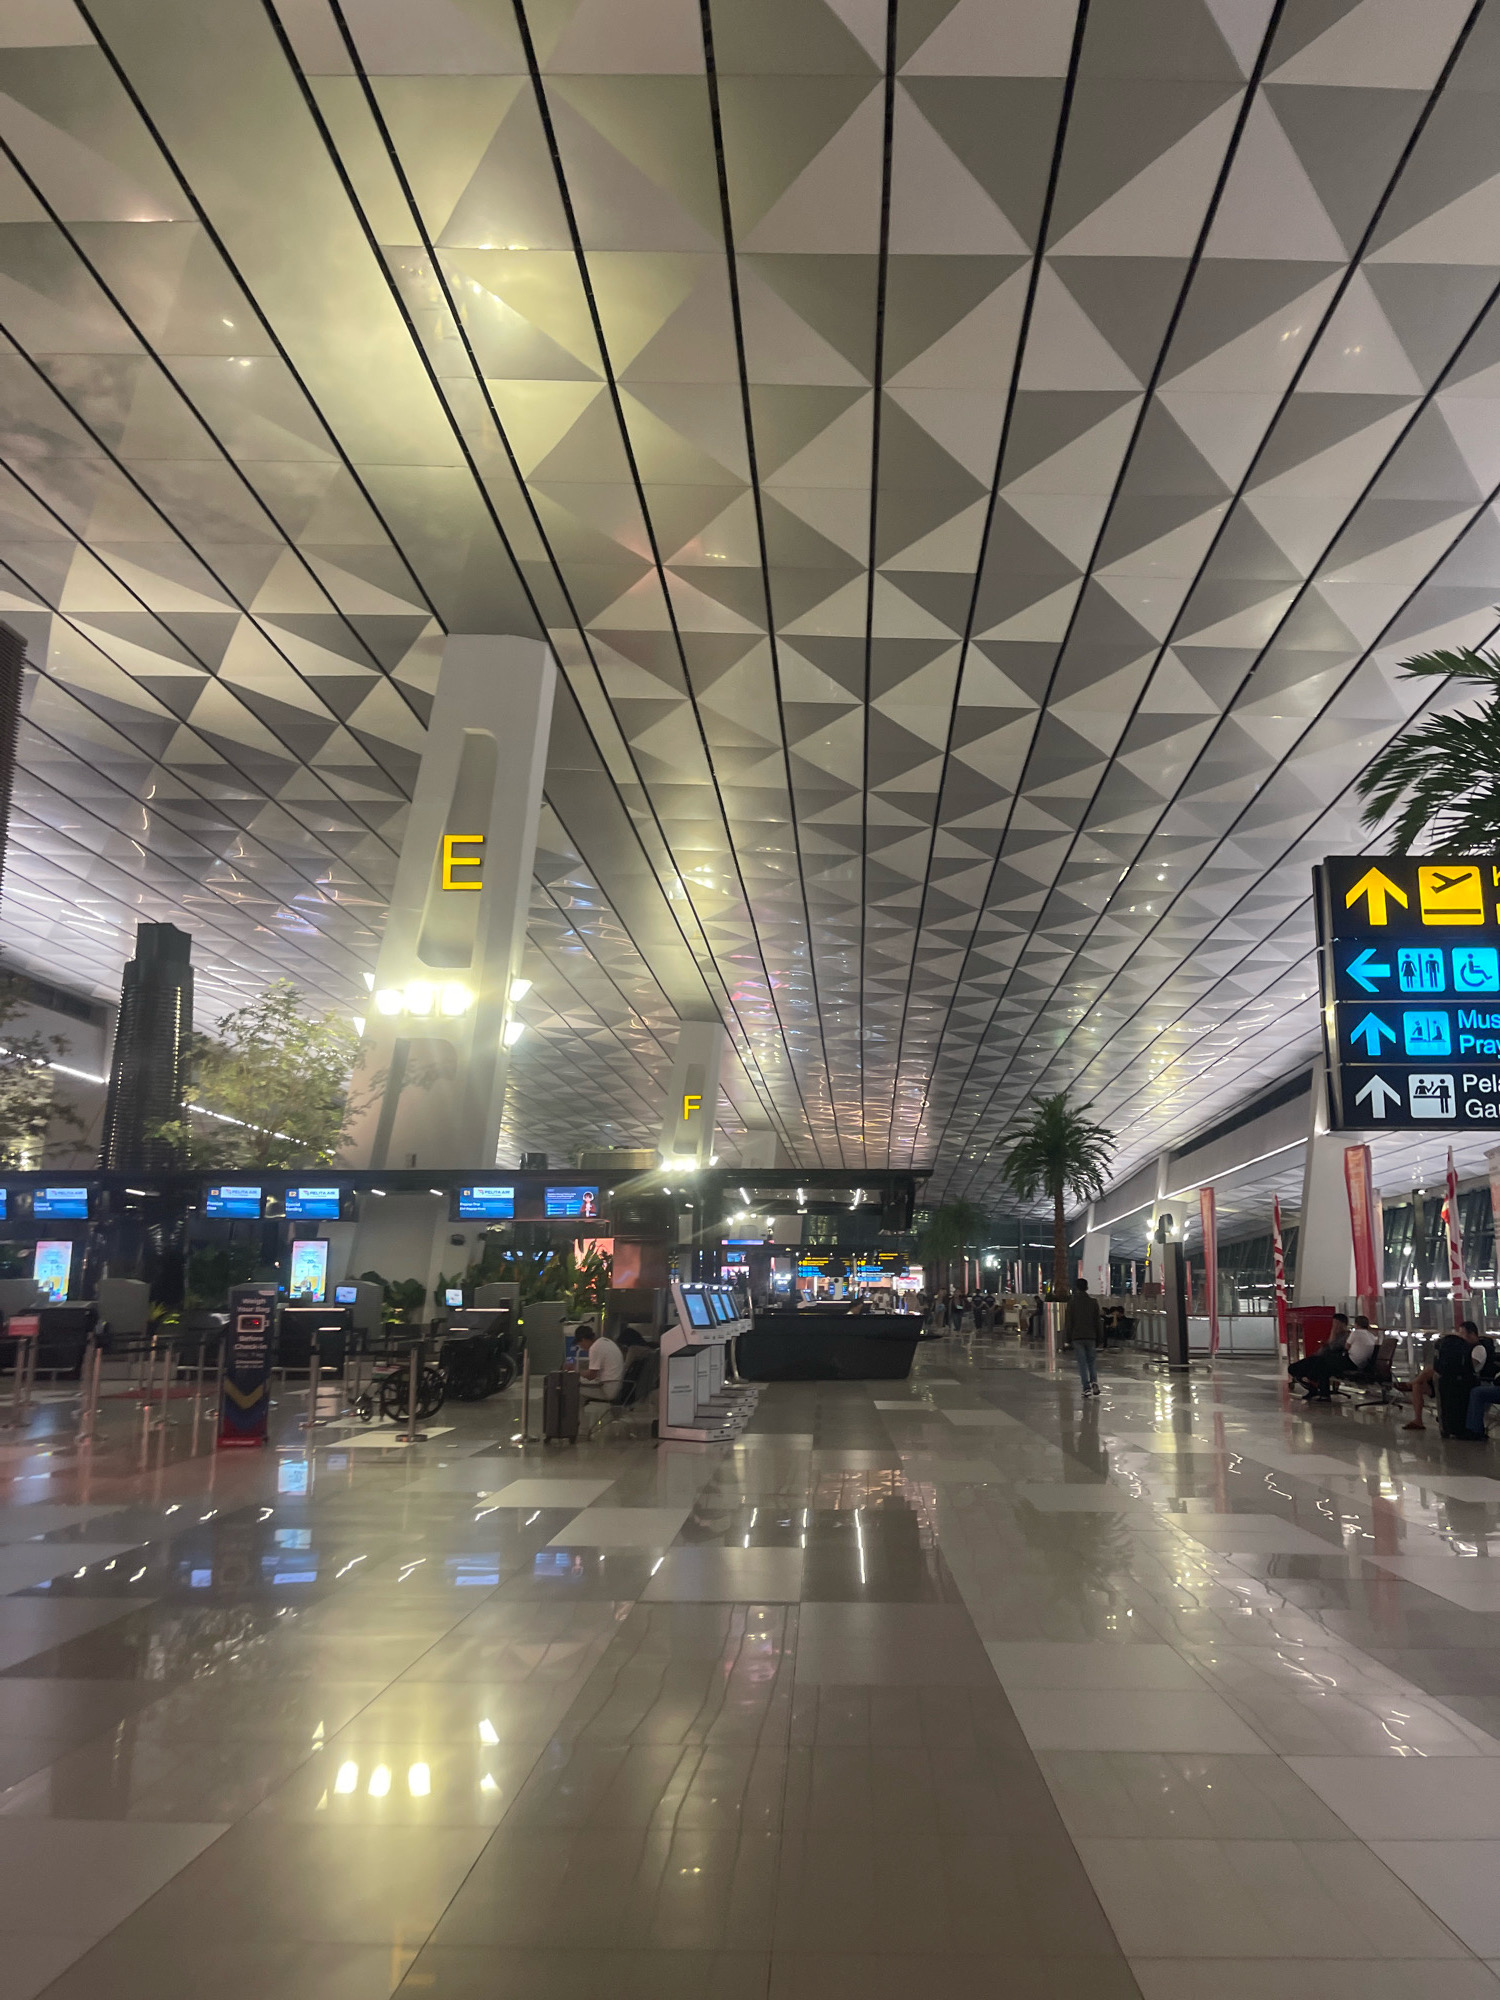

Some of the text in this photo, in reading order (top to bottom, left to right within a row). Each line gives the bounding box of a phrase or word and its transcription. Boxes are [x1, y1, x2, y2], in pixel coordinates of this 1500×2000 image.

[442, 835, 484, 890] E
[1462, 1073, 1500, 1093] Pel
[684, 1095, 702, 1120] F
[1465, 1098, 1500, 1119] Ga
